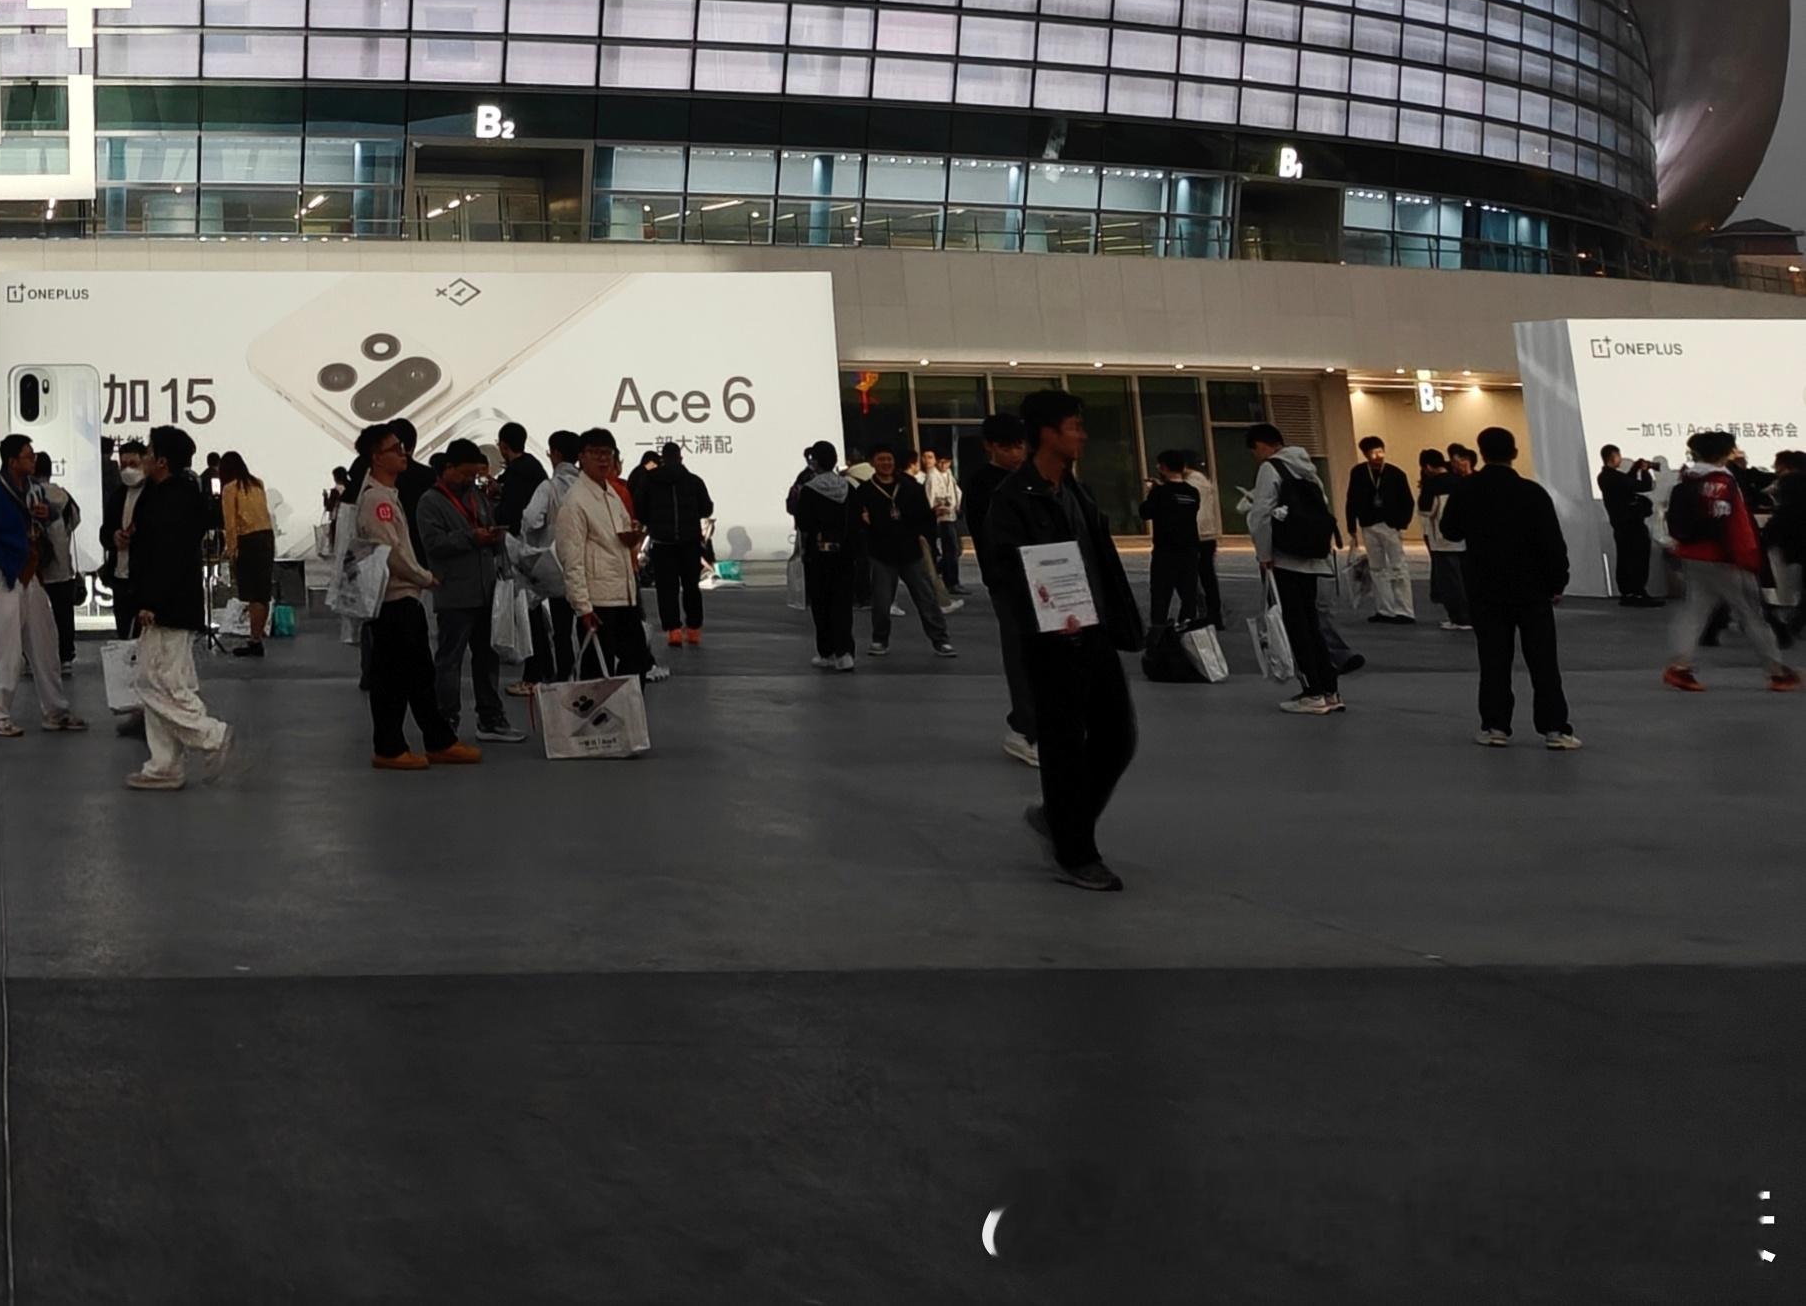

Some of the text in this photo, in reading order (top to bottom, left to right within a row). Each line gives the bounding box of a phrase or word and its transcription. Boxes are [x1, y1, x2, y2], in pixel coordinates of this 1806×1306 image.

[475, 104, 515, 140] B2
[1278, 146, 1303, 179] B1
[27, 288, 90, 300] ONEPLUS
[1614, 343, 1684, 355] ONEPLUS
[609, 376, 756, 424] Ace 6
[1727, 422, 1799, 439] 新品发布会
